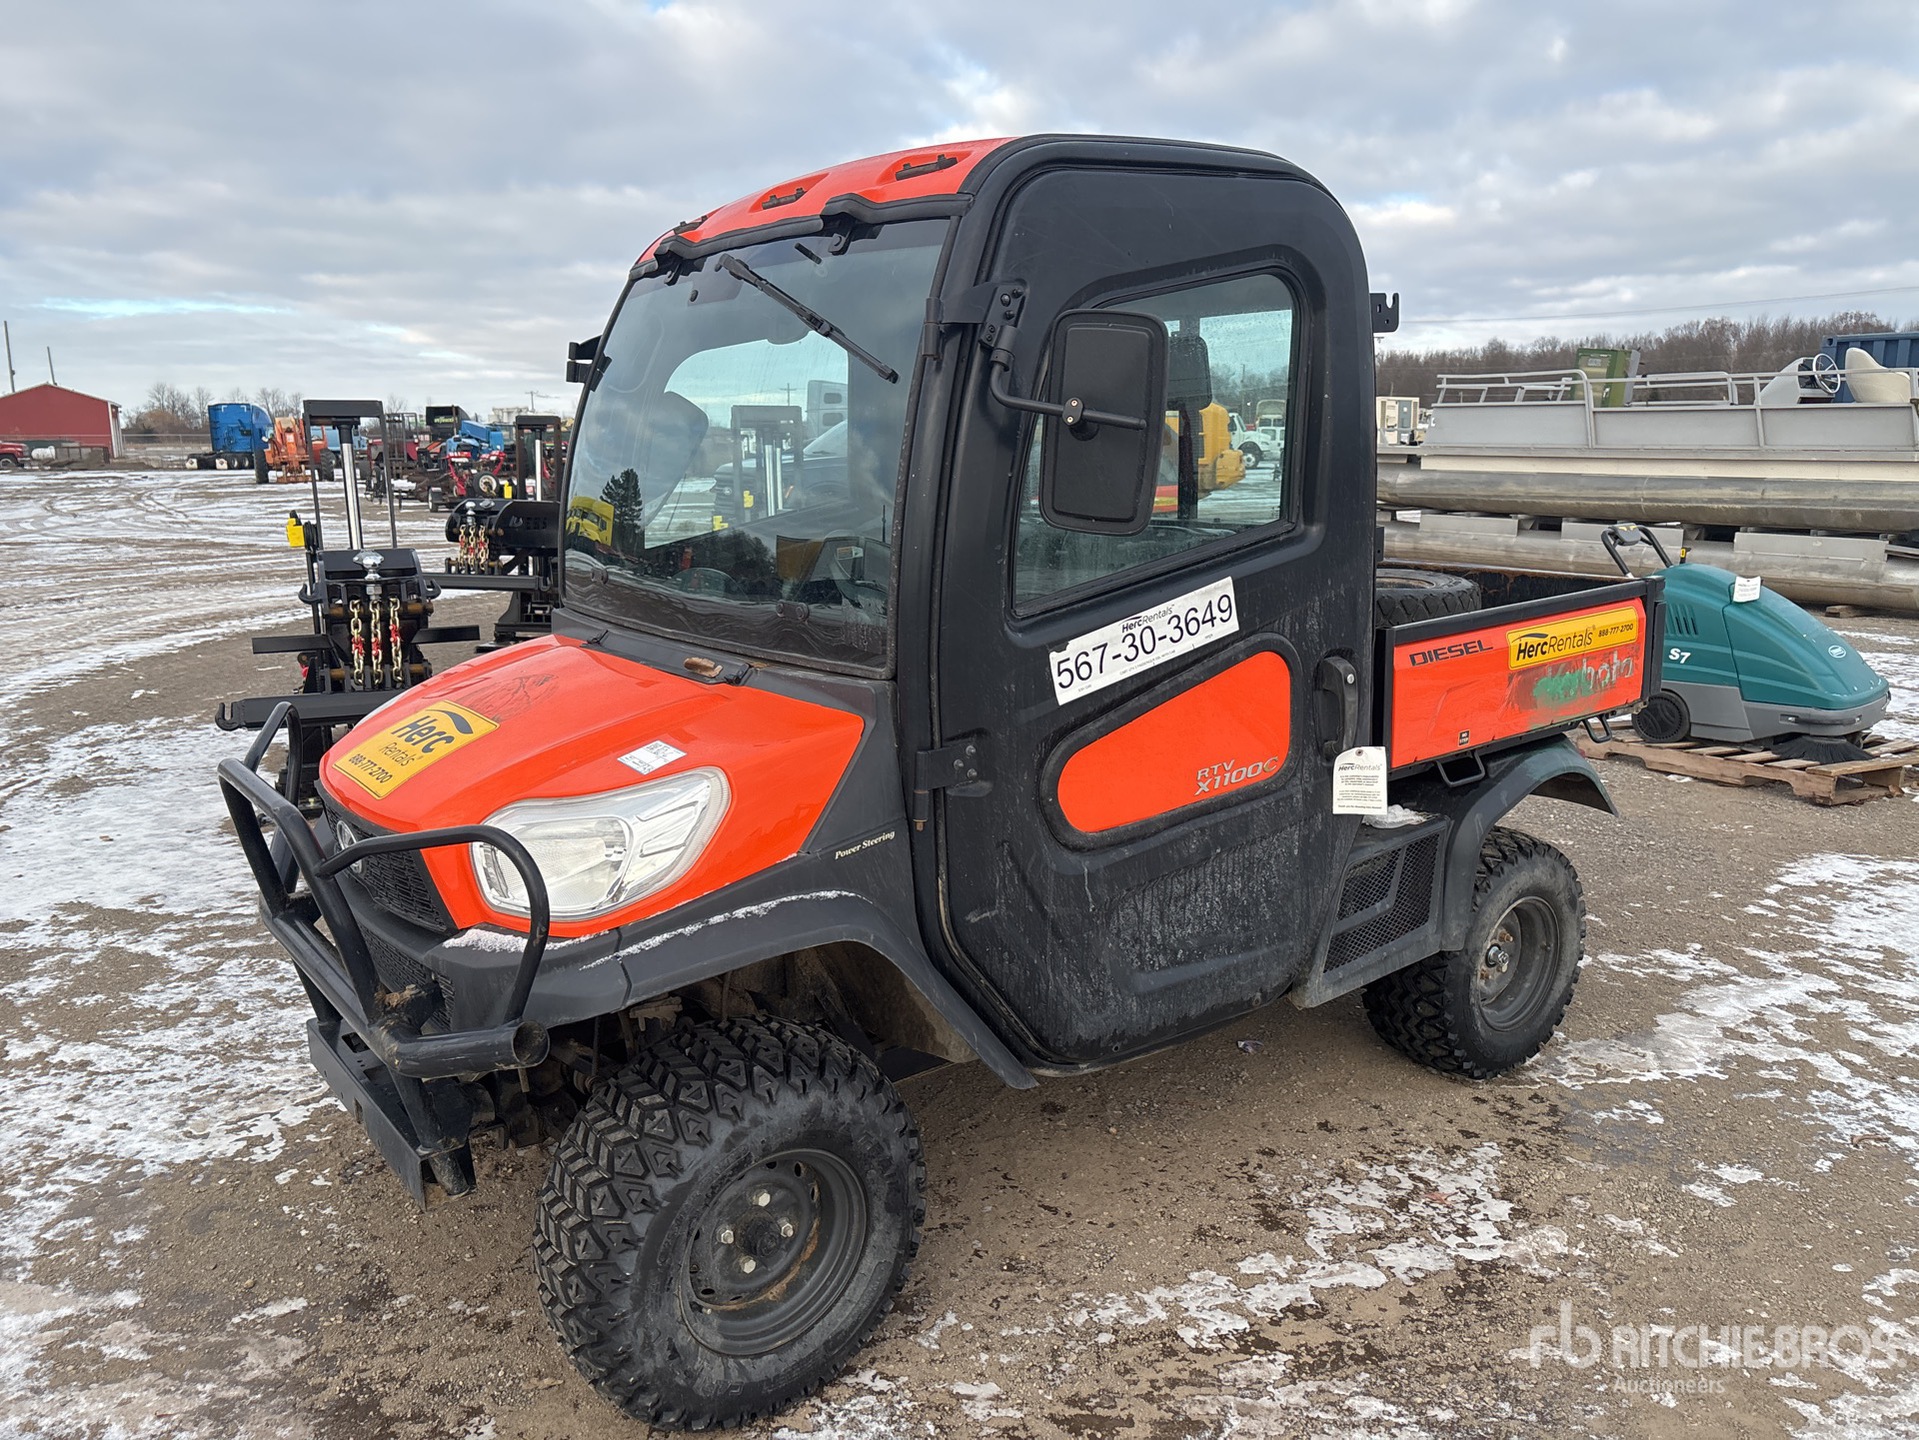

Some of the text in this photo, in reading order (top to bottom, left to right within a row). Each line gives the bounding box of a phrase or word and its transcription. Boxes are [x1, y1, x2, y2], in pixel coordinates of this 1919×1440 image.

[1056, 594, 1233, 689] 567-30-3649
[1598, 623, 1634, 637] 888-777-2700
[1409, 639, 1493, 667] DIESEL
[1668, 647, 1691, 664] S7
[391, 715, 455, 754] Herc
[348, 753, 393, 784] 888-777-2700
[379, 742, 416, 767] Rentals
[1194, 756, 1279, 797] X1100C
[1197, 759, 1235, 780] RTV
[834, 831, 896, 860] Power Steering
